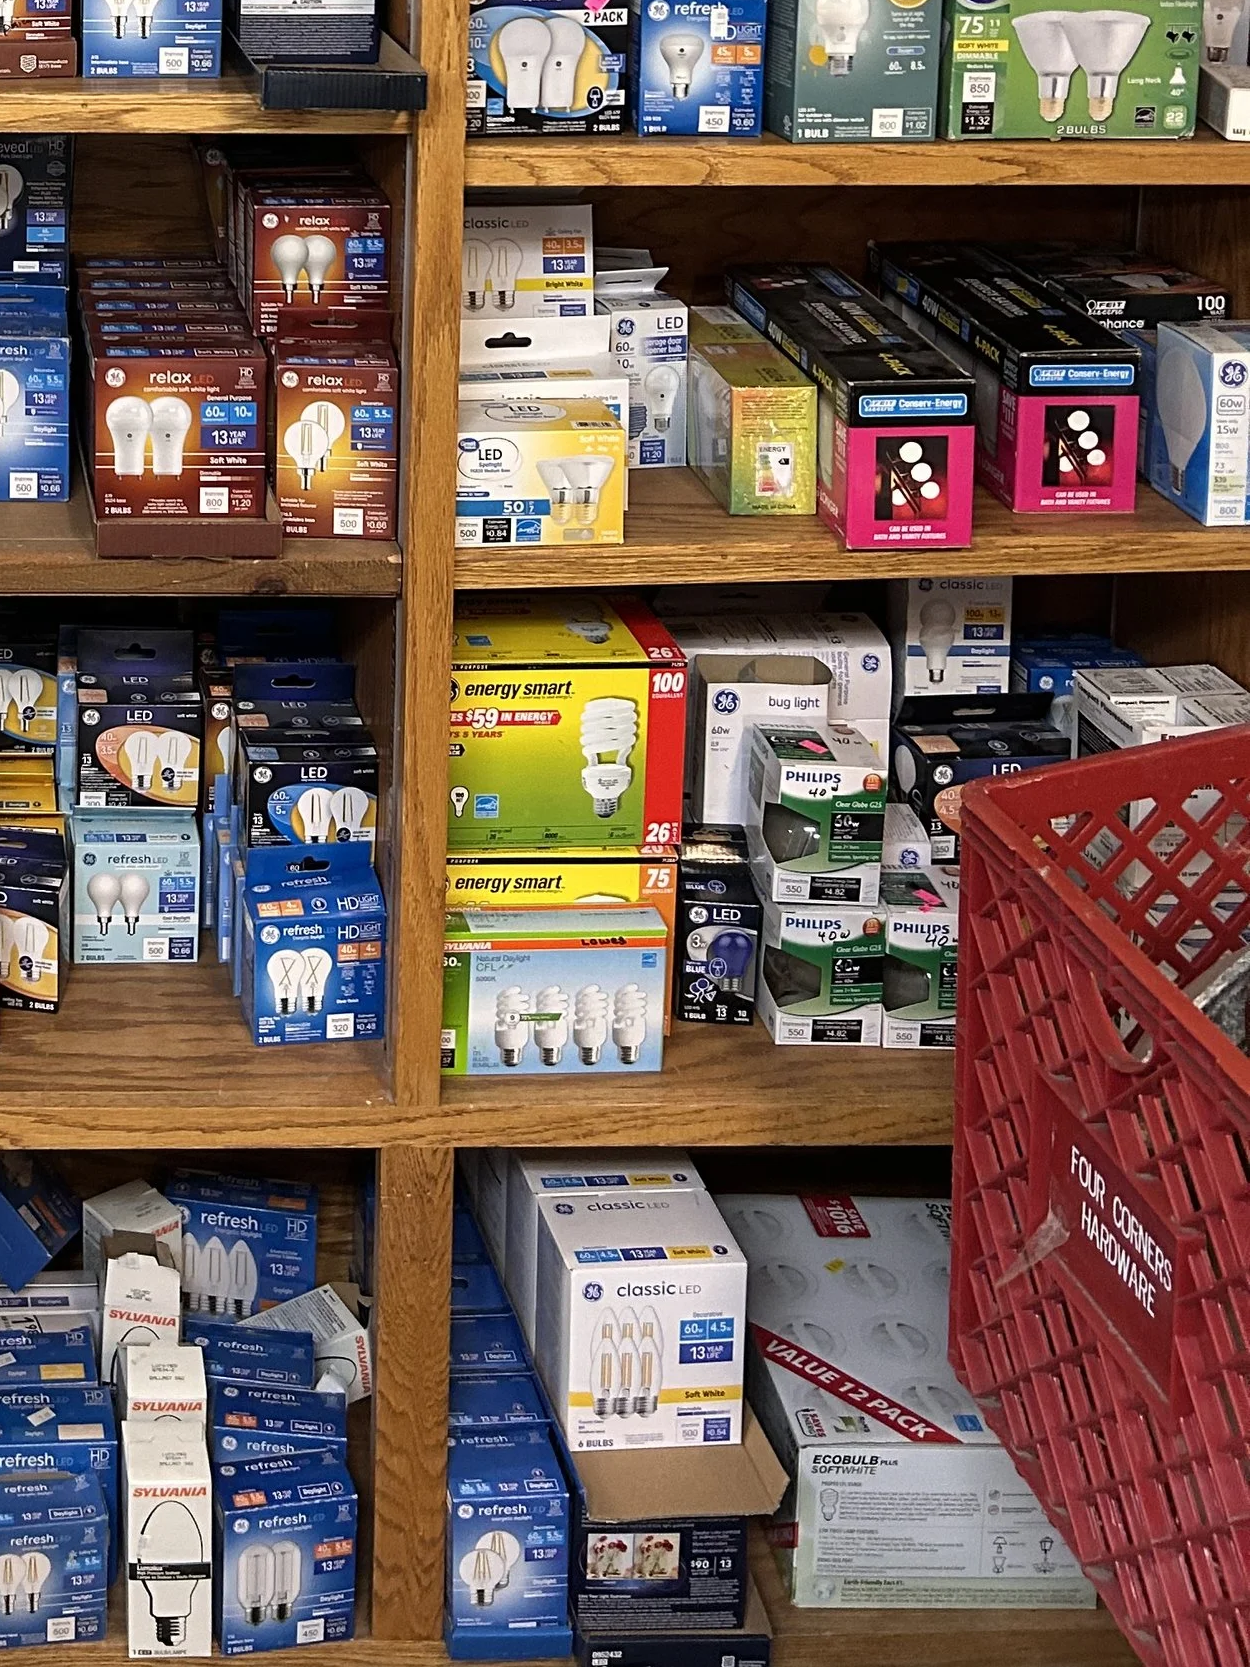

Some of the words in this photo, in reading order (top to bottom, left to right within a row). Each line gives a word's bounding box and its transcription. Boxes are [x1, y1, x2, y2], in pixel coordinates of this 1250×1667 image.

[584, 12, 590, 22] 2
[595, 11, 623, 22] PACK
[959, 16, 984, 33] 75
[970, 84, 990, 93] 850
[1057, 125, 1064, 134] 2
[1065, 125, 1106, 134] BULBS
[299, 215, 330, 226] relax
[1196, 296, 1224, 310] 100
[657, 316, 683, 330] LED
[149, 371, 192, 385] relax
[307, 374, 343, 387] relax
[1220, 398, 1242, 410] 60w
[478, 449, 502, 461] LED
[653, 673, 684, 692] 100
[464, 682, 520, 700] energy
[523, 681, 572, 696] smart
[768, 696, 789, 711] bug
[791, 696, 820, 709] light
[501, 713, 512, 721] IN
[514, 711, 554, 723] ENERGY
[786, 771, 841, 784] PHILIPS
[646, 824, 670, 842] 26
[108, 854, 151, 866] refresh
[454, 876, 509, 893] energy
[514, 875, 562, 889] smart
[646, 868, 669, 887] 75
[786, 917, 841, 930] PHILIPS
[893, 922, 949, 934] PHILIPS
[283, 925, 323, 937] refresh
[503, 954, 530, 962] Daylight
[477, 962, 496, 971] CFL
[587, 1201, 645, 1212] classic
[1071, 1145, 1106, 1208] FOUR
[1112, 1193, 1173, 1292] CORNERS
[1082, 1201, 1156, 1318] HARDWARE
[617, 1281, 676, 1296] classic
[679, 1284, 701, 1295] LED
[109, 1310, 176, 1327] SYLVANIA
[356, 1335, 370, 1394] SYLVANIA
[765, 1338, 838, 1385] VALUE
[836, 1378, 869, 1406] 12
[868, 1392, 935, 1440] PACK
[132, 1401, 203, 1413] SYLVANIA
[813, 1454, 878, 1466] ECOBULB
[133, 1487, 207, 1498] SYLVANIA
[478, 1504, 527, 1516] refresh
[258, 1513, 308, 1527] refresh
[10, 1535, 55, 1546] refresh
